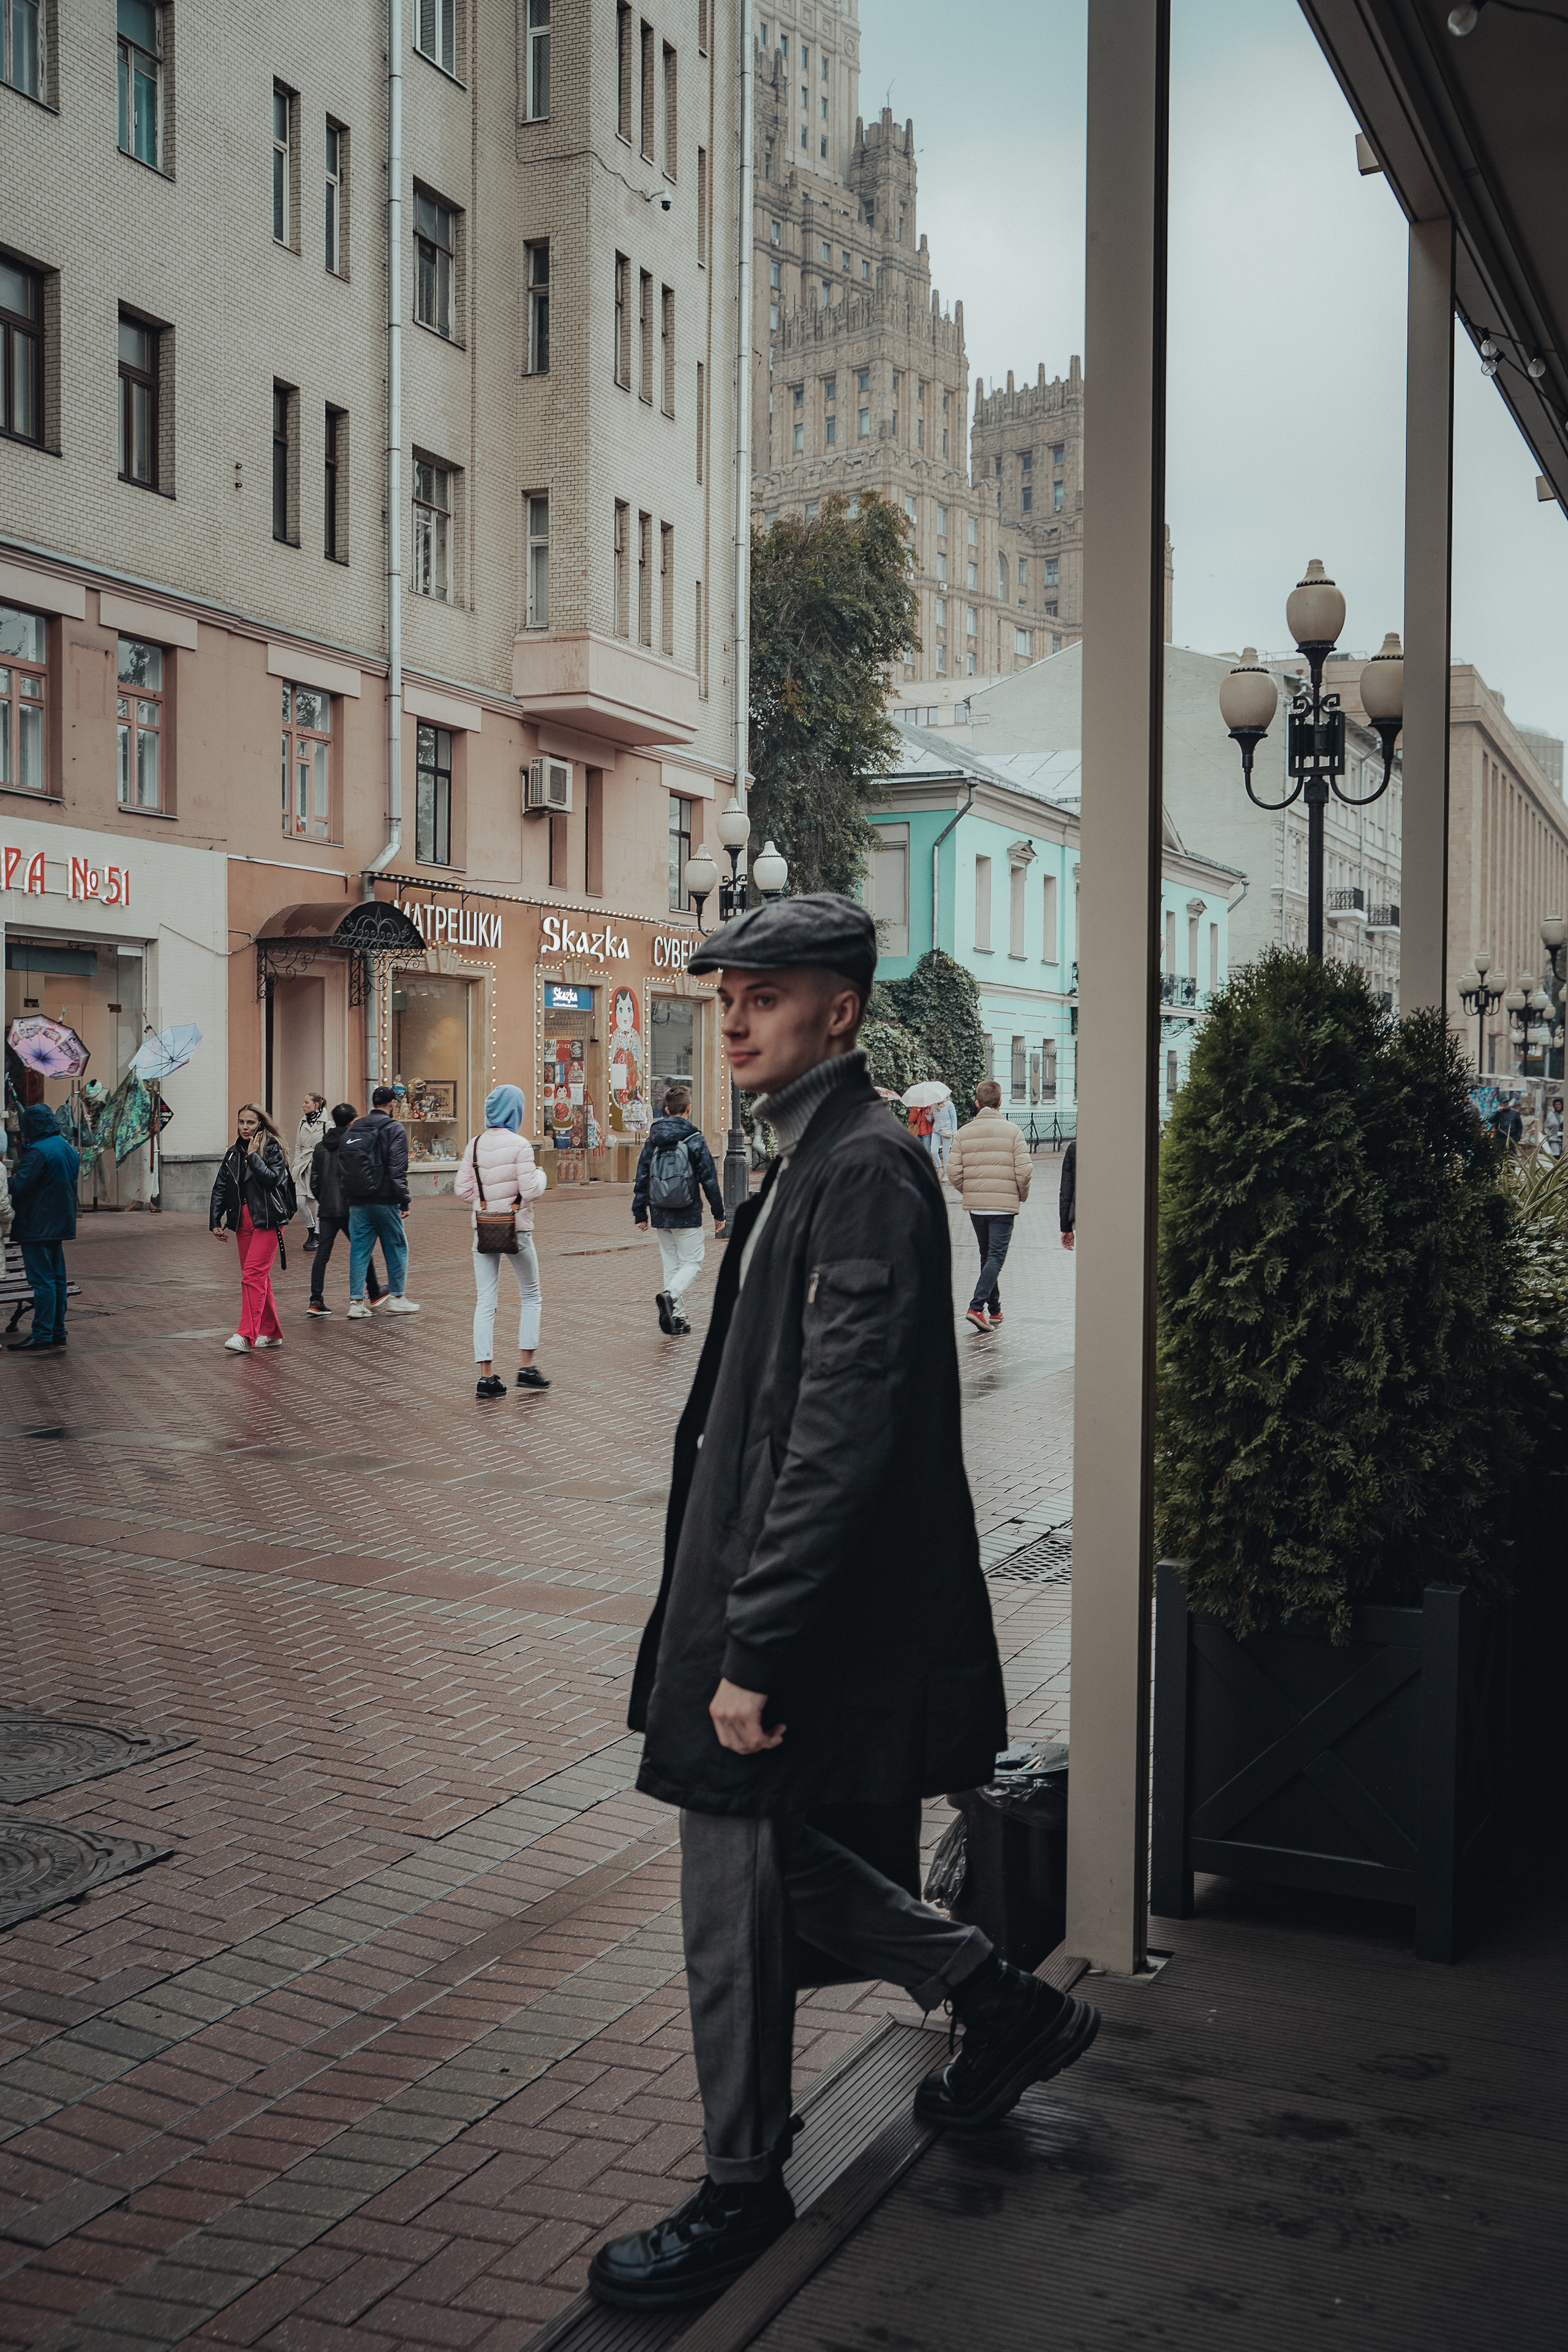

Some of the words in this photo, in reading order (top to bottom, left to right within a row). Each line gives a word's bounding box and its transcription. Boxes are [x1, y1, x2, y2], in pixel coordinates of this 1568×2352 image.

[541, 916, 630, 963] Skazka
[654, 935, 703, 969] СУВЕН
[552, 987, 578, 1004] Skazka
